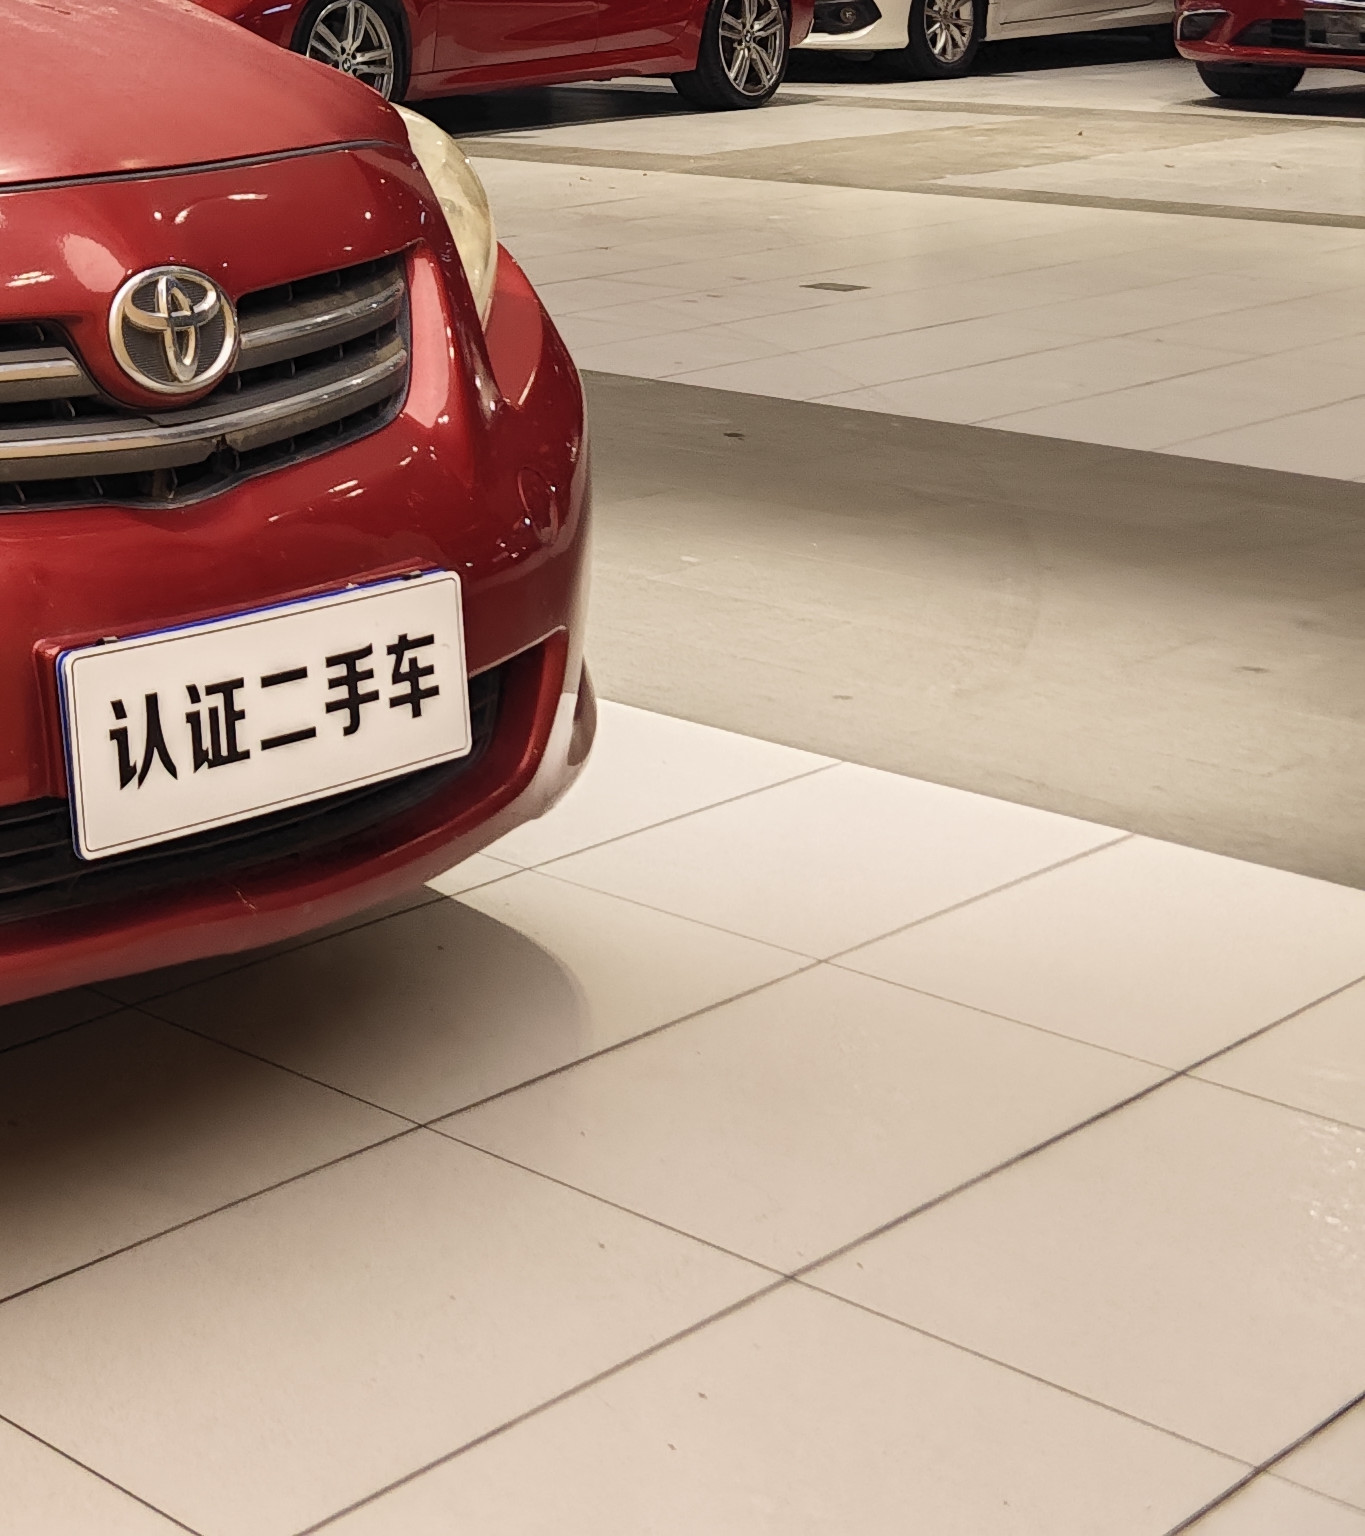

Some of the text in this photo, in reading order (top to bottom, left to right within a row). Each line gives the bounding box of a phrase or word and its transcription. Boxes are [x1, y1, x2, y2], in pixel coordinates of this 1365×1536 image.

[109, 632, 440, 790] 认证二手车
